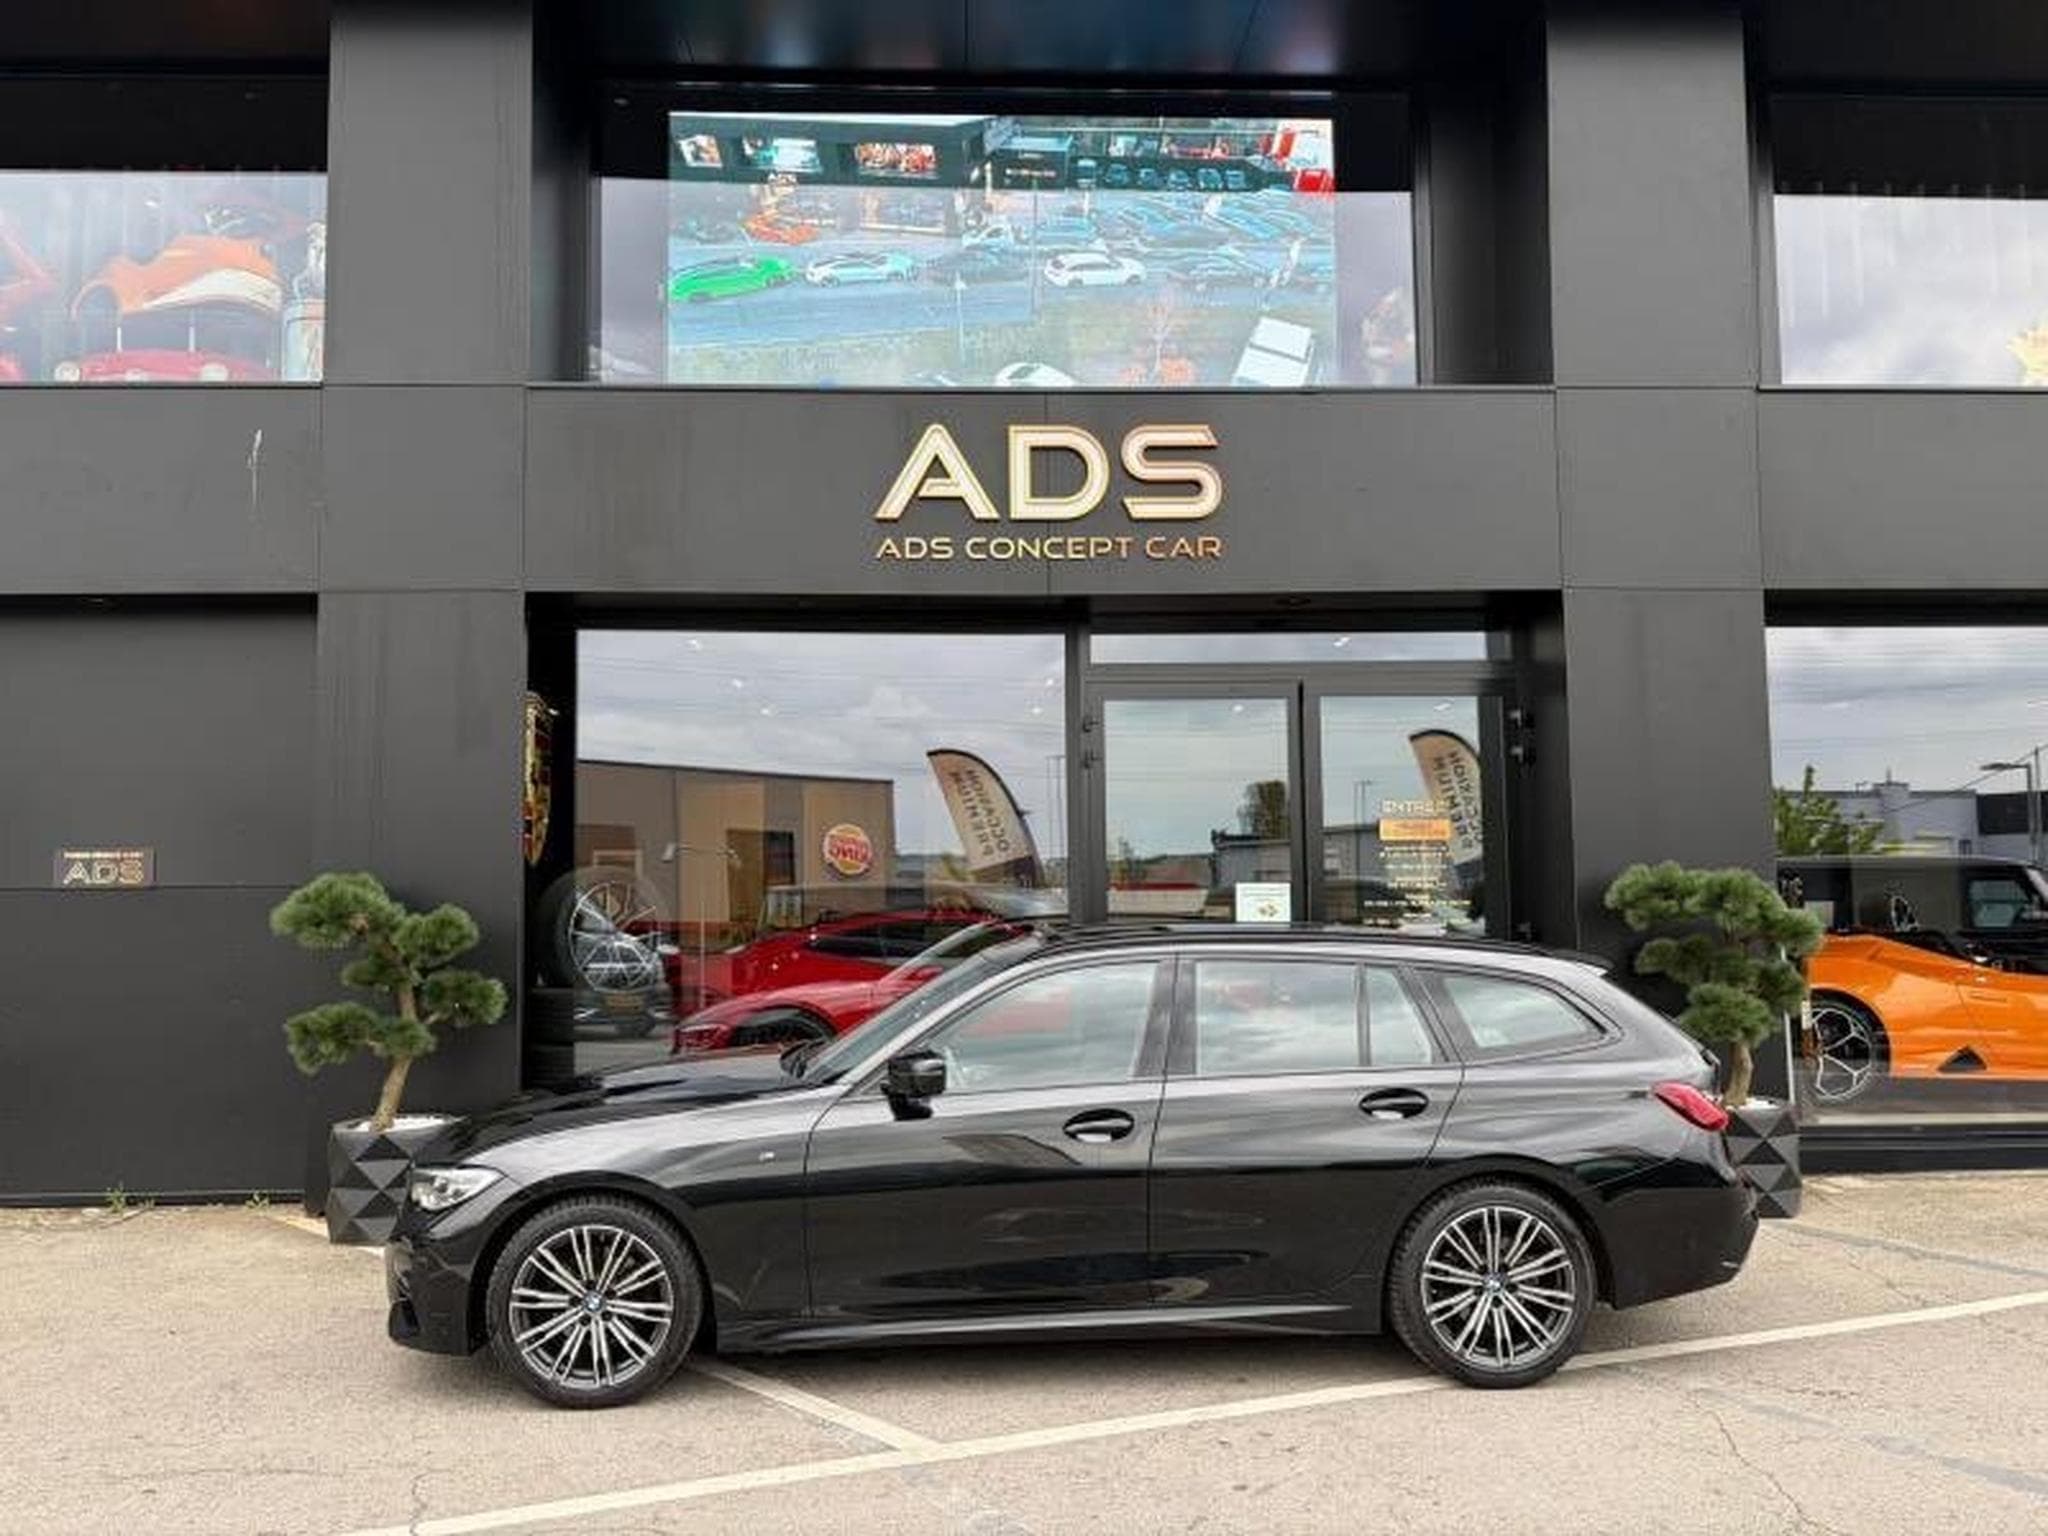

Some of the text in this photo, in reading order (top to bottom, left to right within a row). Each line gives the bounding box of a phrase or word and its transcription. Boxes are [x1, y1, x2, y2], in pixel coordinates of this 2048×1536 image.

[874, 423, 1223, 521] ADS
[876, 537, 1222, 560] ADS CONCEPT CAR
[63, 861, 144, 885] ADS
